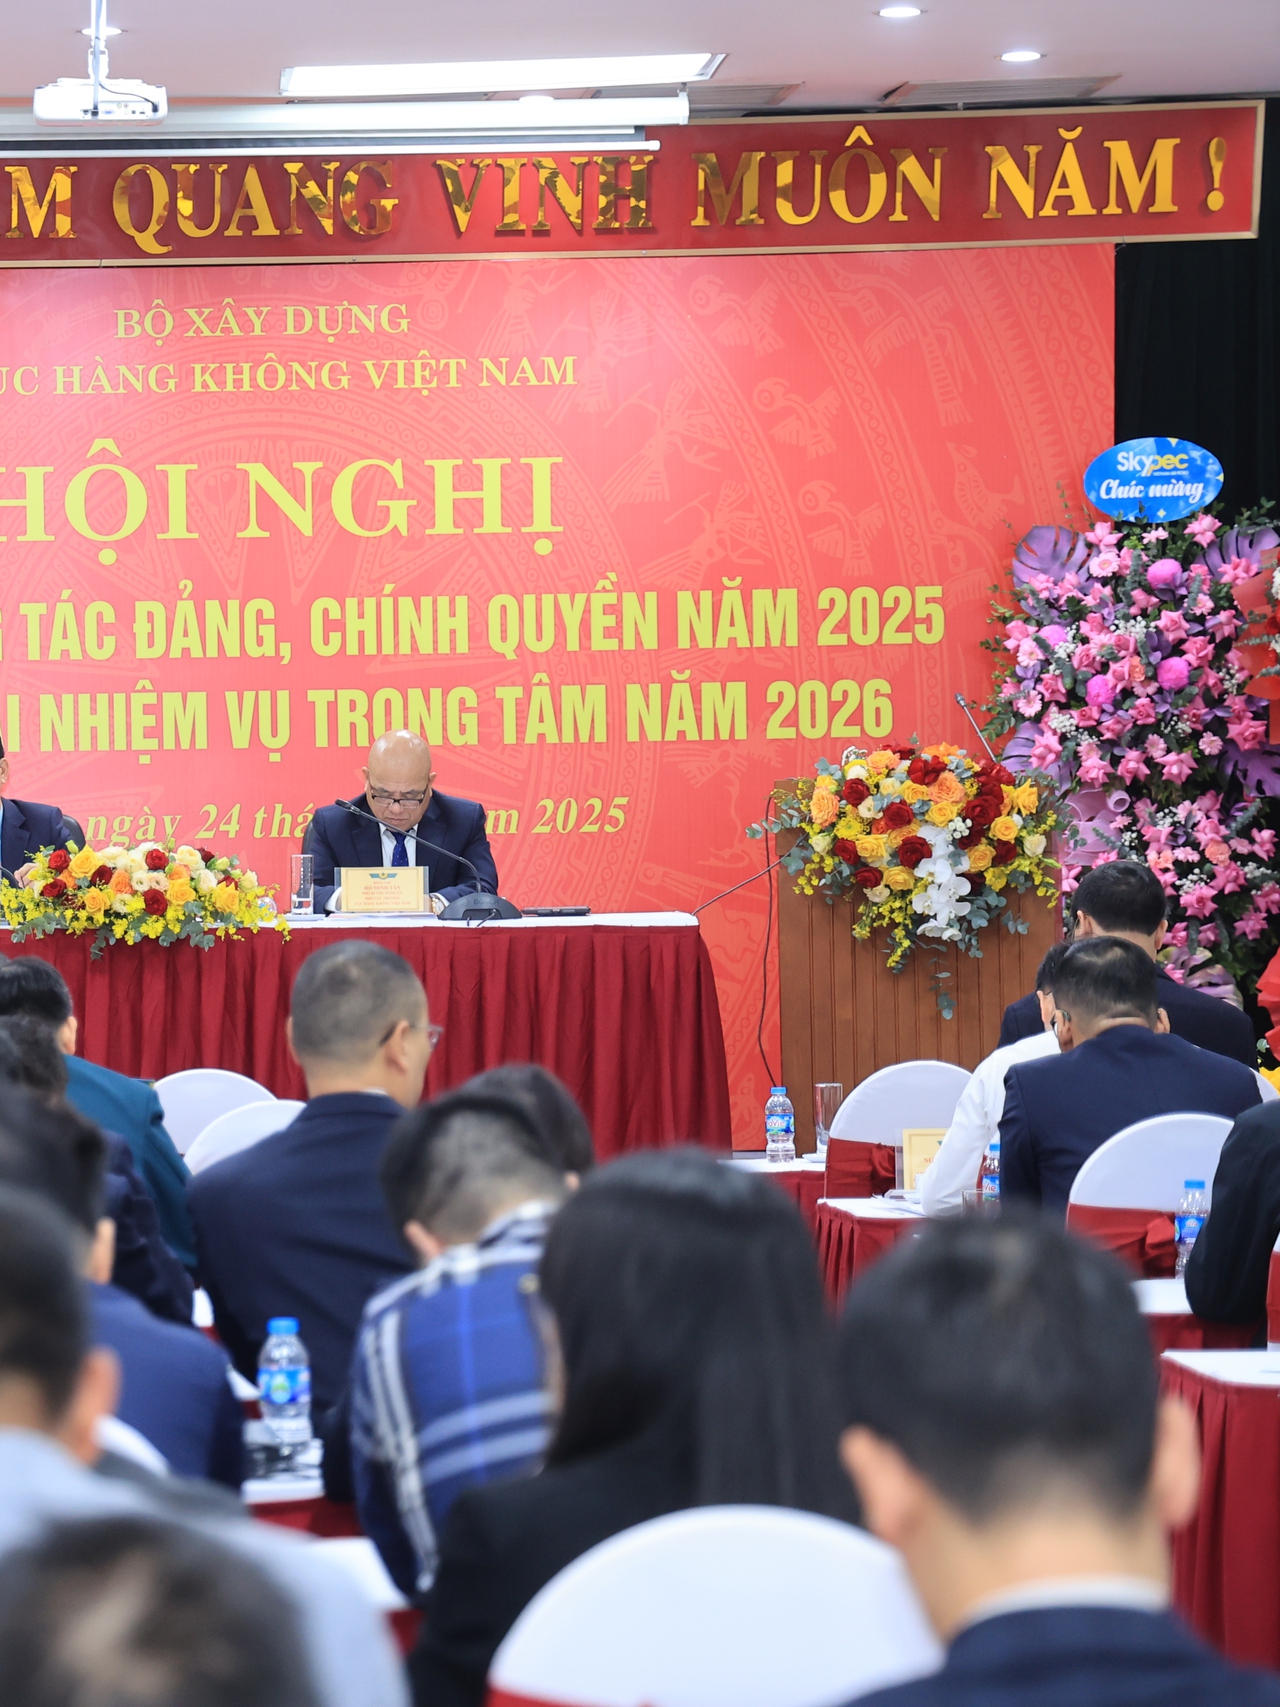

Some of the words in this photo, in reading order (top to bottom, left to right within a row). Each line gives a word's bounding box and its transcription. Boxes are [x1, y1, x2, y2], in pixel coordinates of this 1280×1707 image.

[112, 160, 399, 254] QUANG
[435, 155, 654, 233] VINH
[690, 125, 948, 226] MUÔN
[114, 299, 174, 346] BỘ
[184, 298, 271, 338] XÂY
[284, 300, 411, 343] DỰNG
[54, 356, 178, 395] HÀNG
[192, 353, 351, 392] KHÔNG
[362, 350, 466, 396] VIỆT
[479, 356, 577, 387] NAM
[1117, 451, 1189, 477] Skypec
[236, 457, 564, 556] NGHỊ
[1100, 479, 1144, 500] Chúc
[1148, 479, 1204, 504] mừng
[20, 589, 117, 660] TÁC
[133, 579, 292, 664] ĐẢNG,
[310, 583, 469, 657] CHÍNH
[488, 571, 659, 660] QUYỀN
[676, 576, 799, 649] NĂM
[817, 585, 945, 645] 2025
[39, 679, 208, 764] NHIỆM
[225, 690, 291, 762] VỤ
[495, 672, 607, 745] TÂM
[625, 669, 748, 742] NĂM
[766, 678, 893, 740] 2026
[84, 806, 183, 848] ngày
[194, 803, 241, 839] 24
[253, 803, 315, 839] thá
[531, 796, 630, 834] 2025
